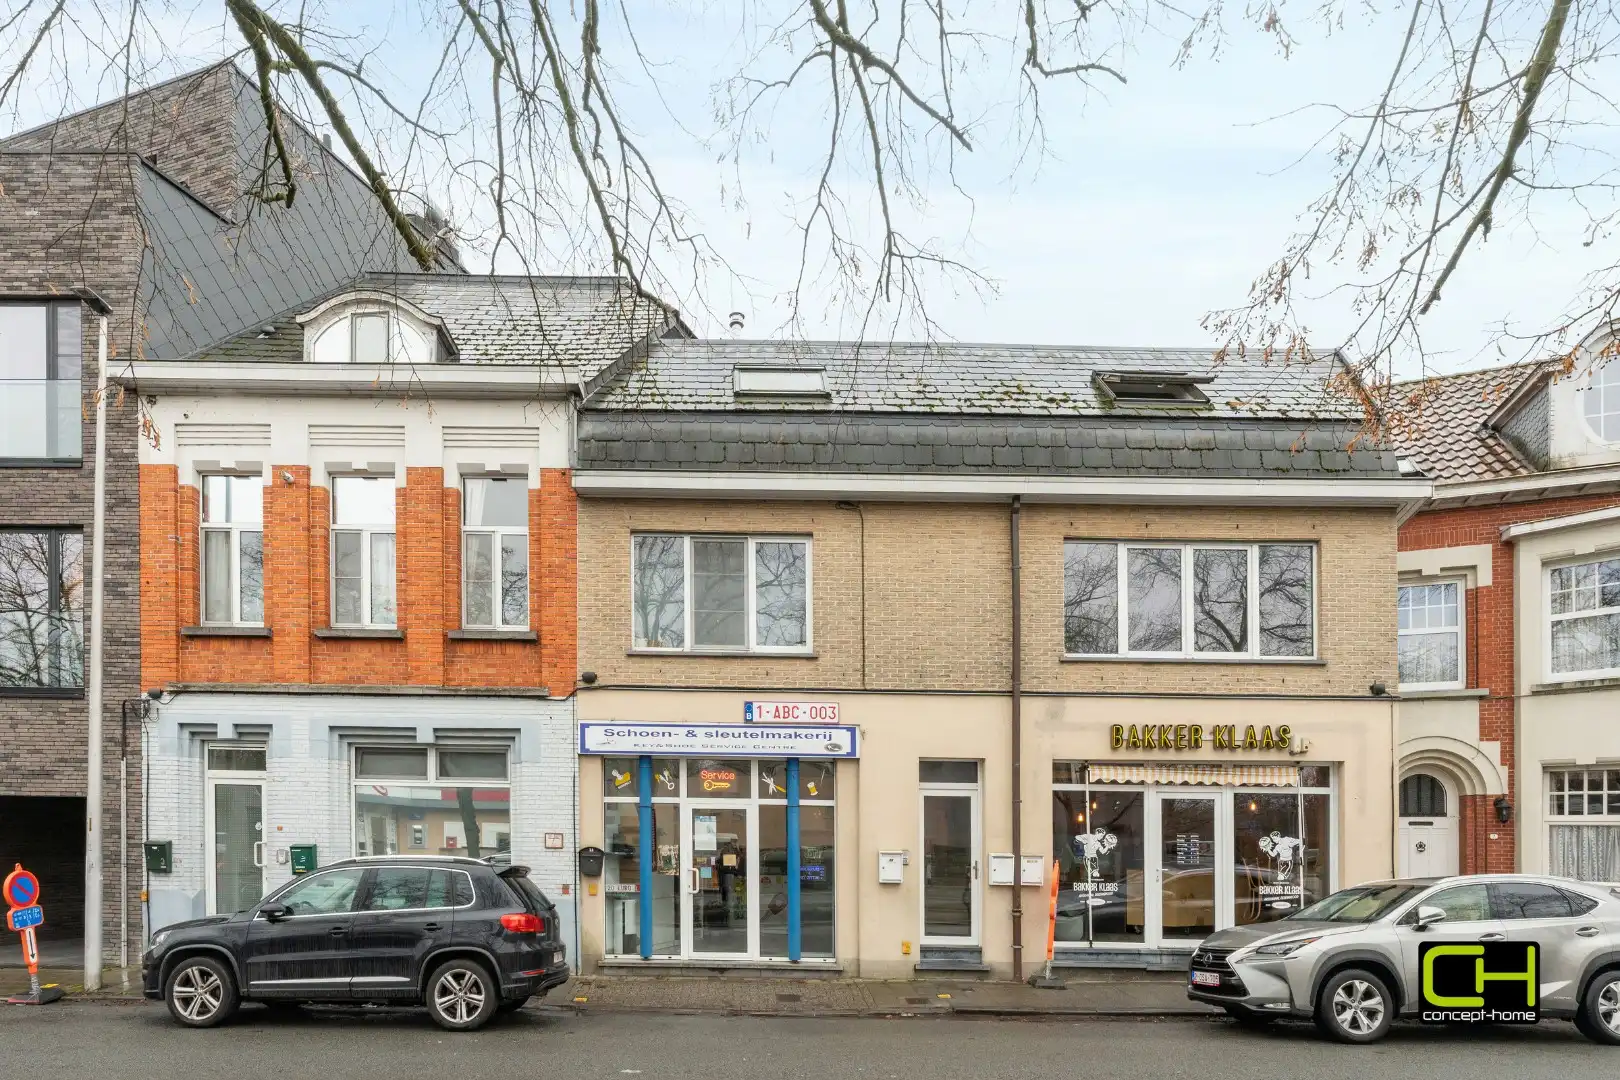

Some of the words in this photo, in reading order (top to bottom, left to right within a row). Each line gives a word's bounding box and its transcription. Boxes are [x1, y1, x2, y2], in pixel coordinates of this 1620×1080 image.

[756, 705, 837, 720] 1-ABC-003
[603, 728, 680, 738] Schoen-
[684, 729, 698, 738] &
[704, 730, 833, 742] sleutelmakerij
[1111, 724, 1204, 749] BAKKER
[1213, 724, 1292, 749] KLAAS
[700, 769, 736, 780] Service
